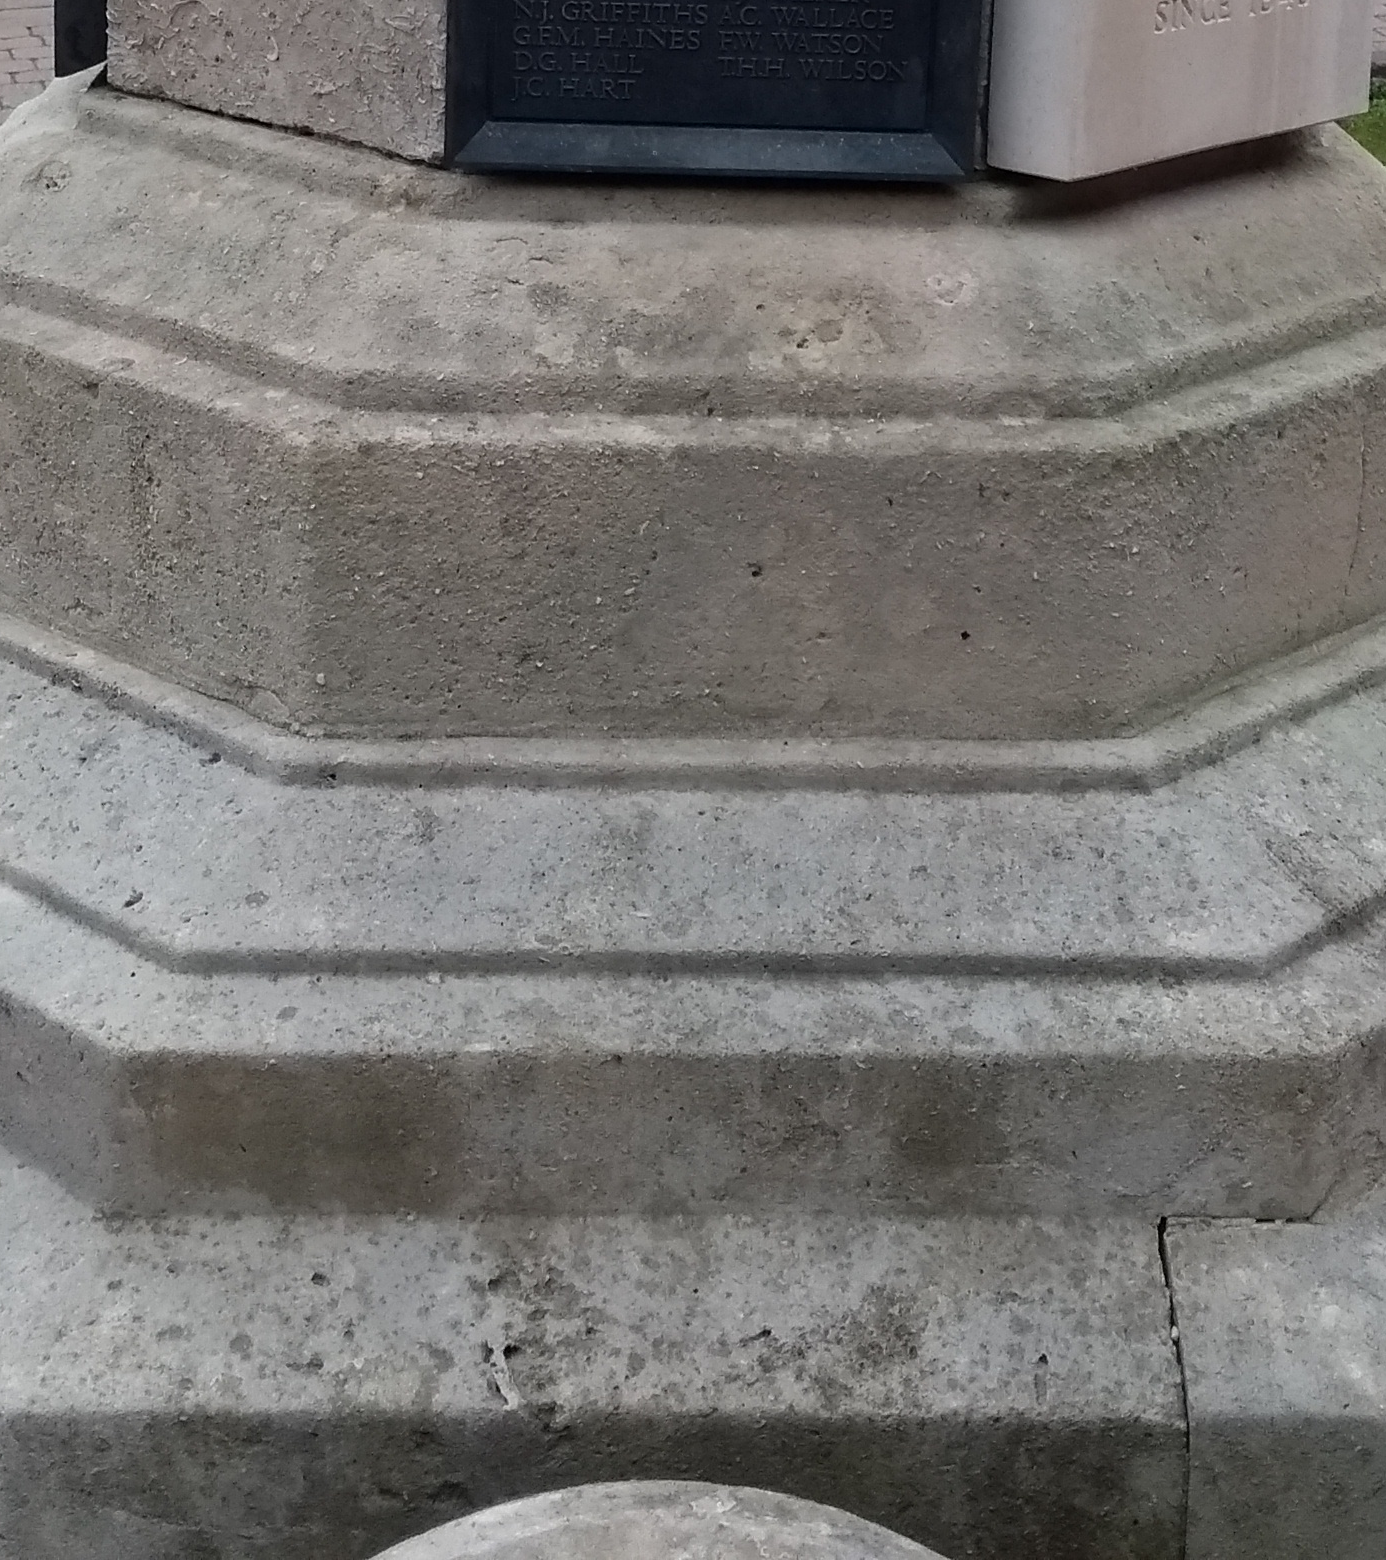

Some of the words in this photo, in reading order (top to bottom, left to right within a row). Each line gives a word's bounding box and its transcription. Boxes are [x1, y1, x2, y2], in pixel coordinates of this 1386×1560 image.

[561, 0, 708, 24] GRIFFITHS
[770, 6, 894, 29] WALLACE
[593, 27, 700, 49] HAINES
[770, 32, 883, 54] WATSON
[571, 52, 644, 74] HALL
[798, 58, 908, 81] WILSON
[558, 78, 636, 99] HART
